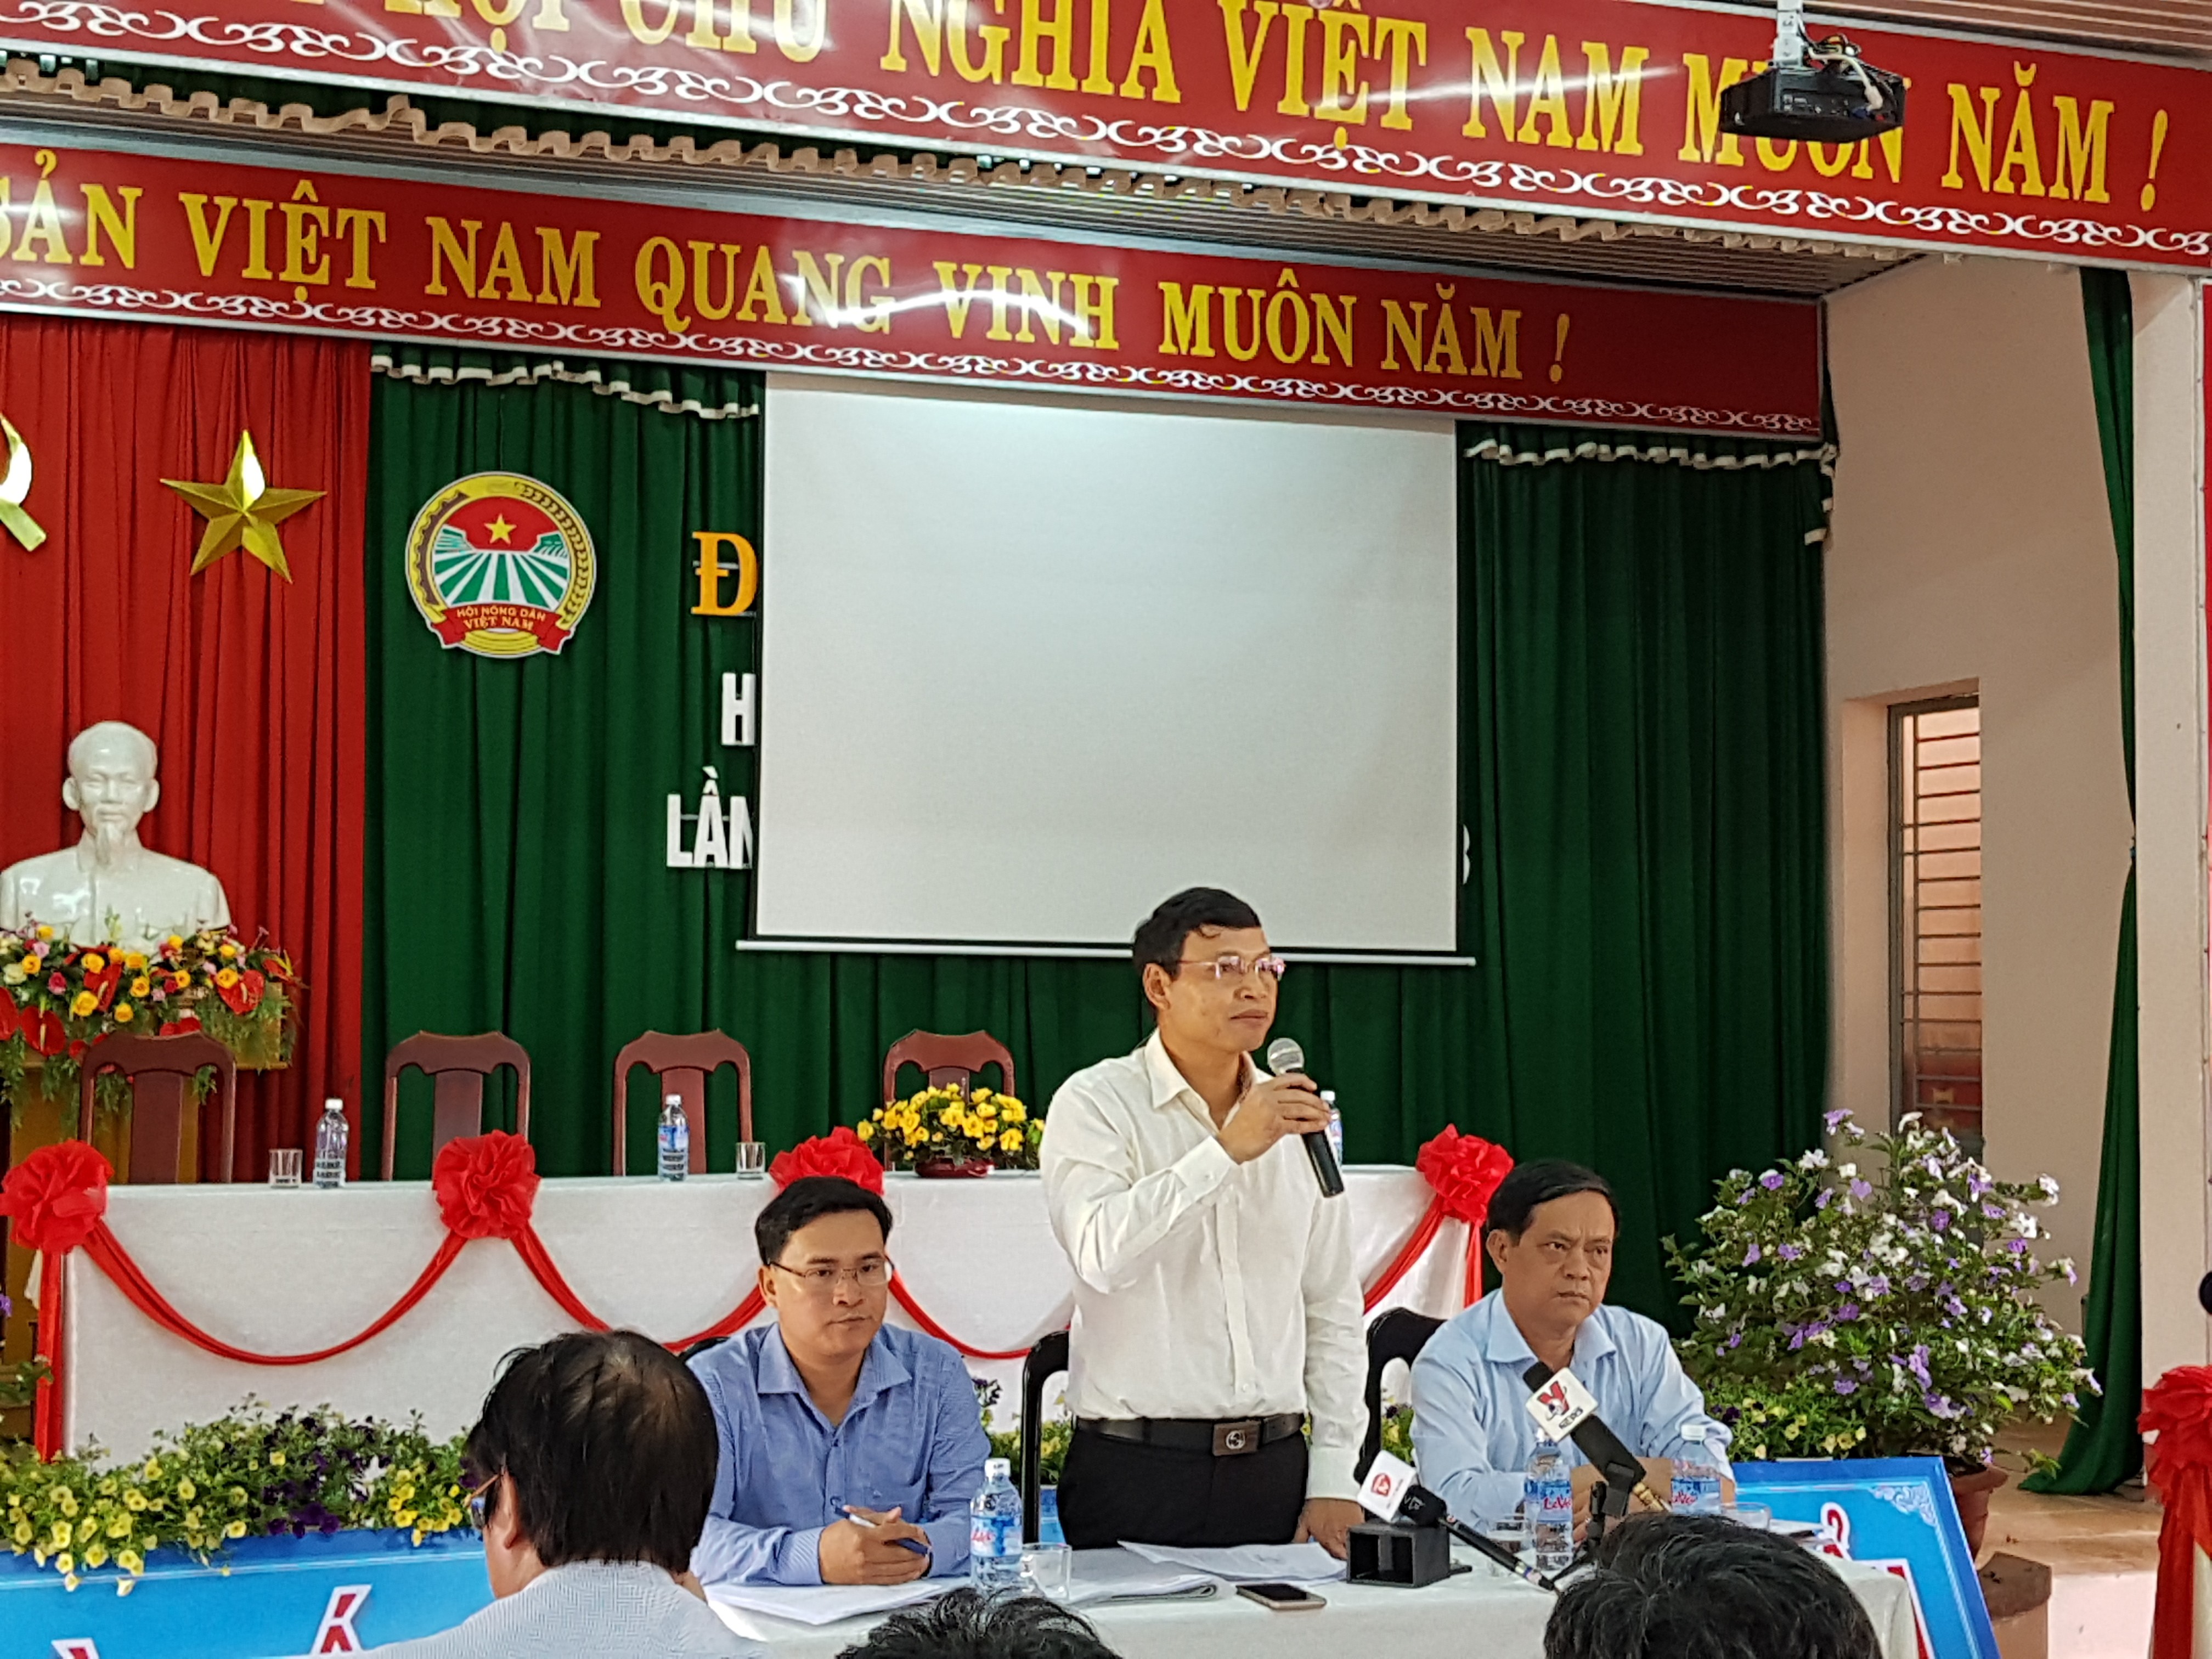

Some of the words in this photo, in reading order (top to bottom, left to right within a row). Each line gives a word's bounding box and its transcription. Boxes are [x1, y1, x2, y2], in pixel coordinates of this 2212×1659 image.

[1217, 0, 1426, 150] VIỆT
[1462, 26, 1649, 156] NAM
[1942, 60, 2115, 204] NĂM
[0, 149, 143, 269] ẢN
[178, 179, 386, 302] VIỆT
[425, 216, 601, 308] NAM
[634, 236, 896, 335] QUANG
[932, 260, 1120, 350] VINH
[1158, 268, 1356, 368] MUÔN
[1380, 282, 1523, 380] NĂM
[501, 616, 534, 631] NAM
